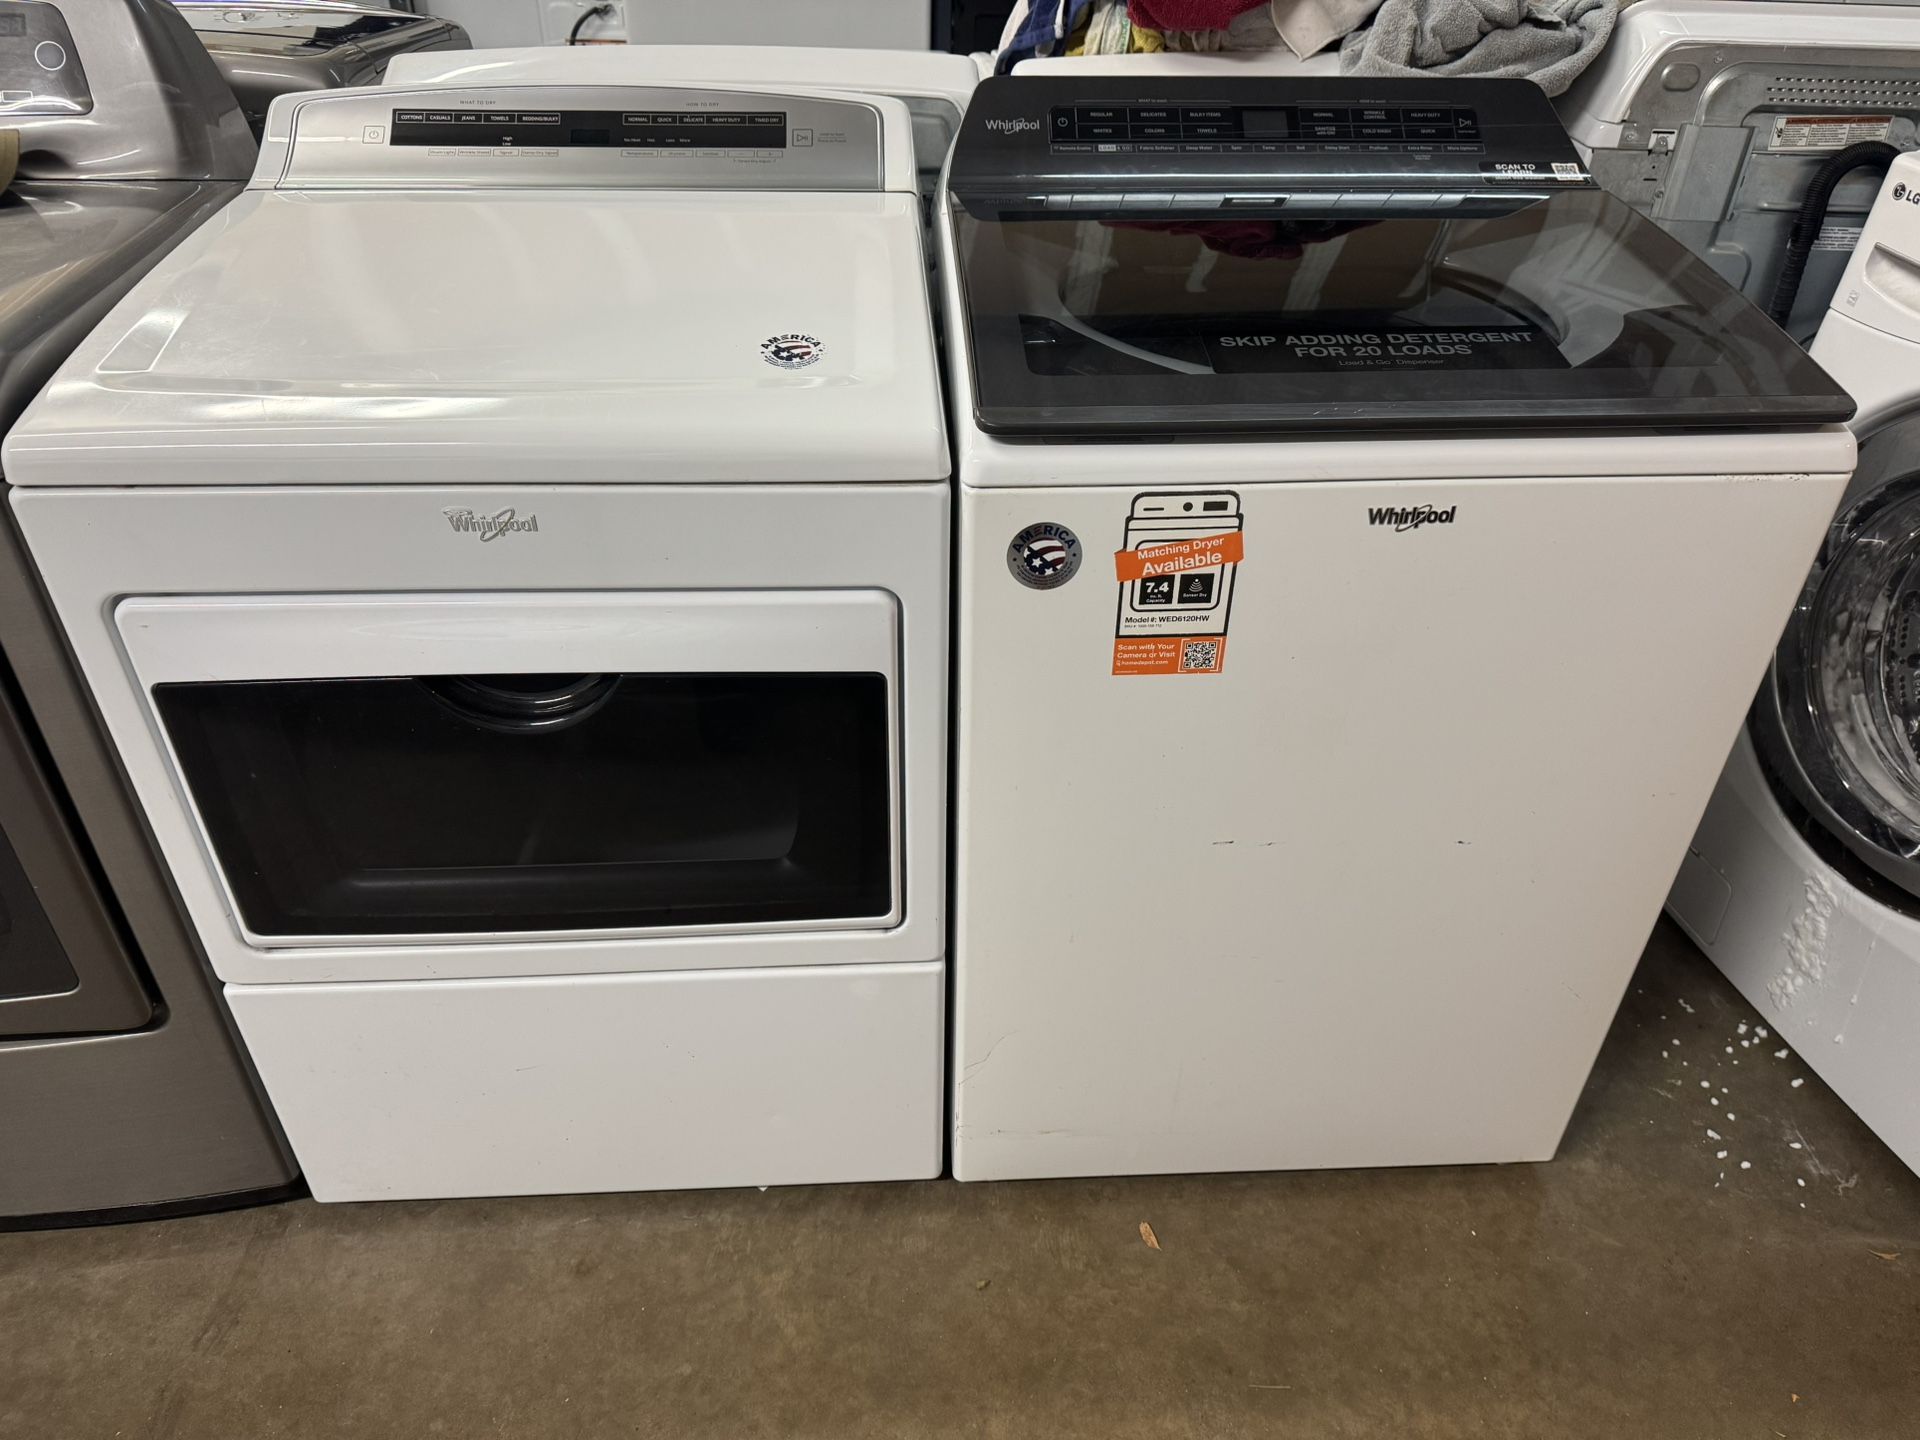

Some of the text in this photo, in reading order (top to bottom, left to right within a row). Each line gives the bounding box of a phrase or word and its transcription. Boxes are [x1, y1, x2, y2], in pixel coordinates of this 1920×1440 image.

[985, 118, 1040, 134] Whirlpool
[1905, 190, 1920, 205] LG
[761, 334, 821, 349] AMERICA
[1219, 332, 1532, 347] SKIP ADDING DETERGENT
[1294, 347, 1347, 357] FOR
[1352, 346, 1382, 356] 20
[443, 508, 539, 542] Whirlpool
[1367, 503, 1457, 532] Whirlpool
[1012, 525, 1076, 553] AMERICA
[1137, 538, 1224, 560] Matching Dryer
[1141, 552, 1222, 575] Available
[1145, 582, 1170, 593] 7.4
[1158, 615, 1210, 623] WED6120HW
